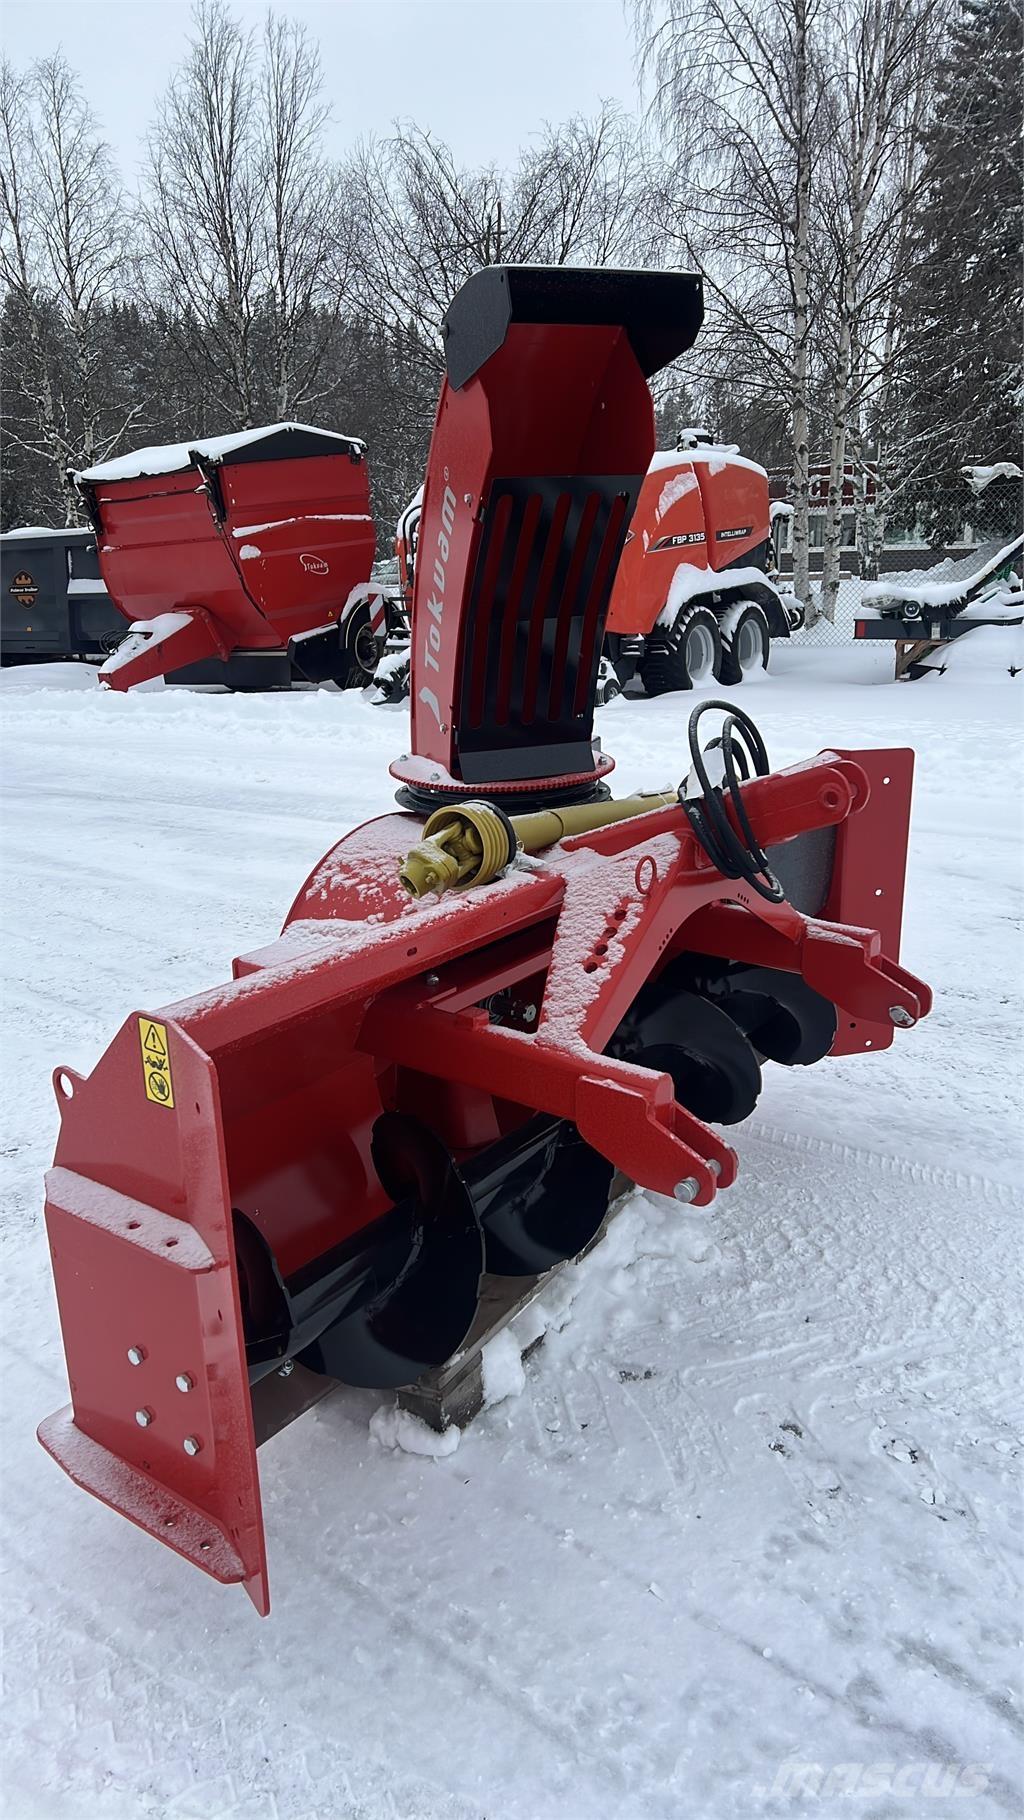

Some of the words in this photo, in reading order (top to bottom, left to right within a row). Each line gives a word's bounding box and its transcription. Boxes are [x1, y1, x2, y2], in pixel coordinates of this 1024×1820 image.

[672, 535, 688, 545] FBP
[688, 532, 706, 543] 3135
[720, 528, 747, 538] INTELLIWRAP
